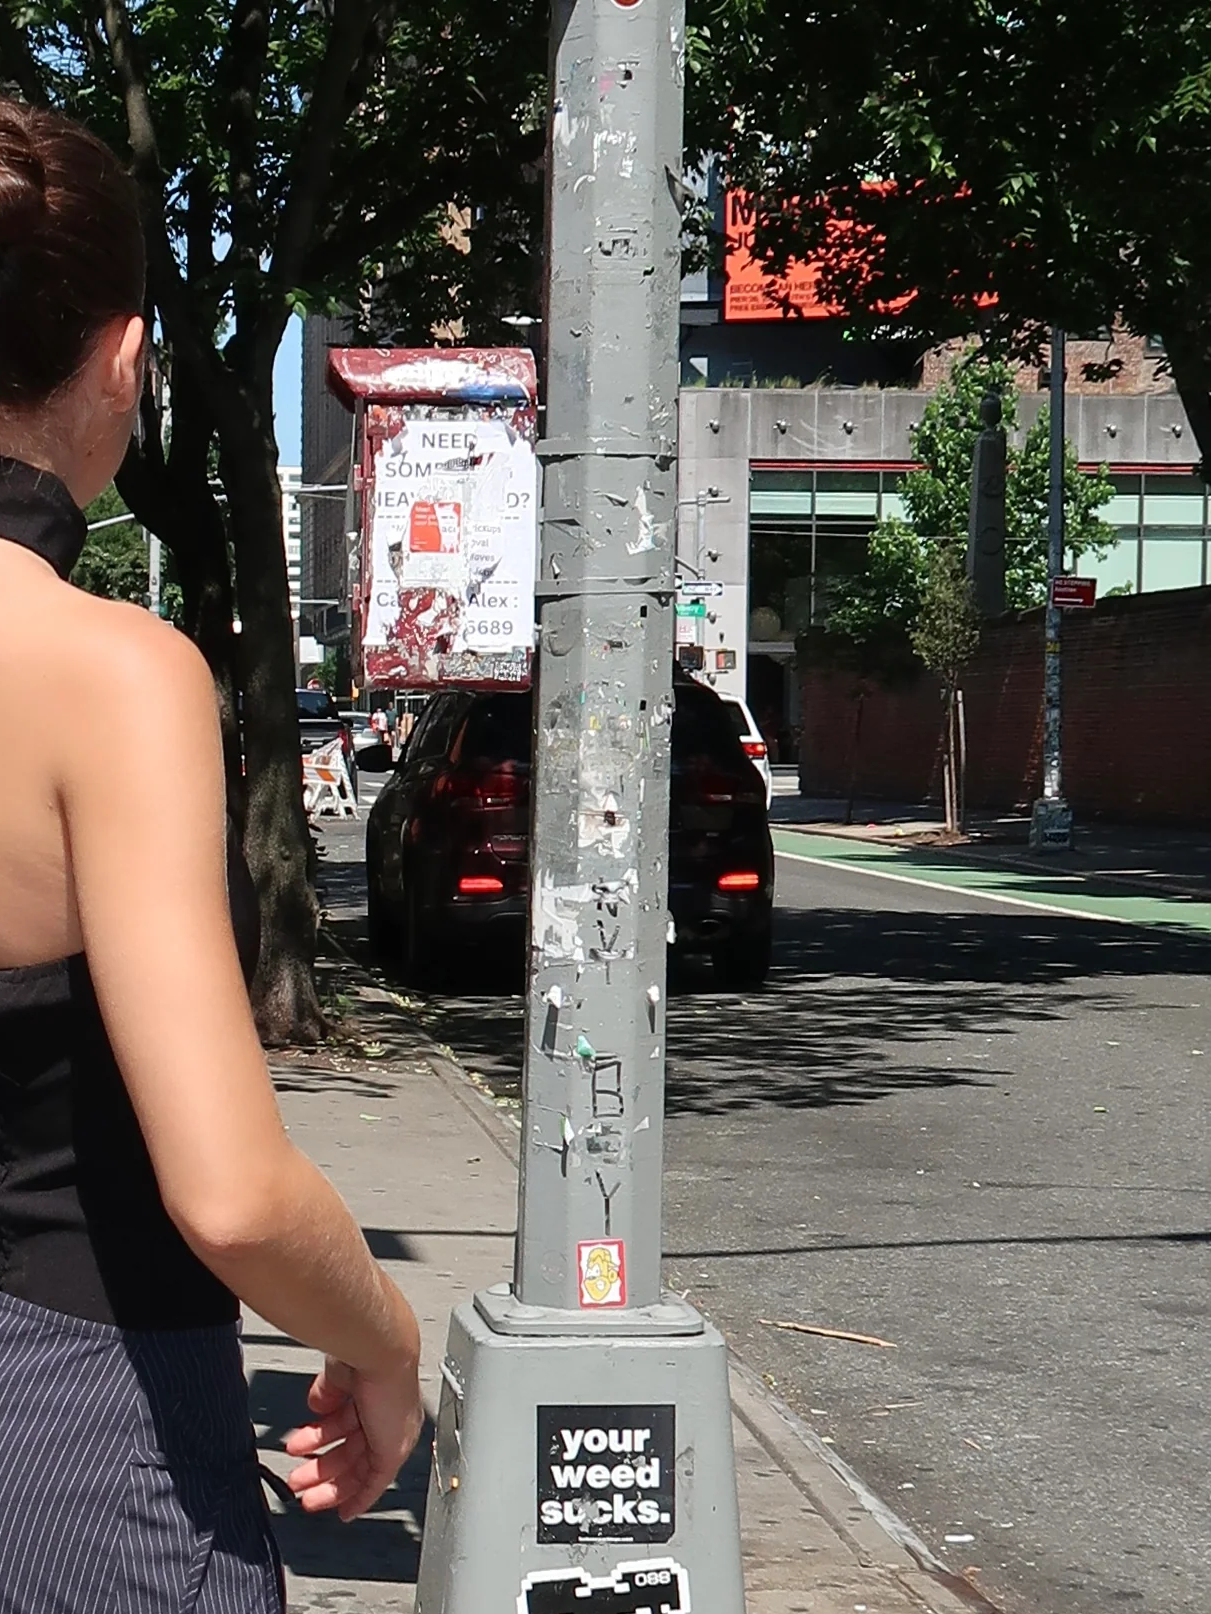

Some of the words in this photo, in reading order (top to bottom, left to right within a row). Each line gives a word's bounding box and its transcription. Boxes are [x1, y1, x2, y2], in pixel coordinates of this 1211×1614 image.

[421, 433, 478, 449] NEED
[376, 592, 396, 607] Ca
[467, 592, 509, 608] Alex
[560, 1428, 651, 1461] your
[551, 1458, 660, 1489] weed
[541, 1493, 671, 1525] sucks.
